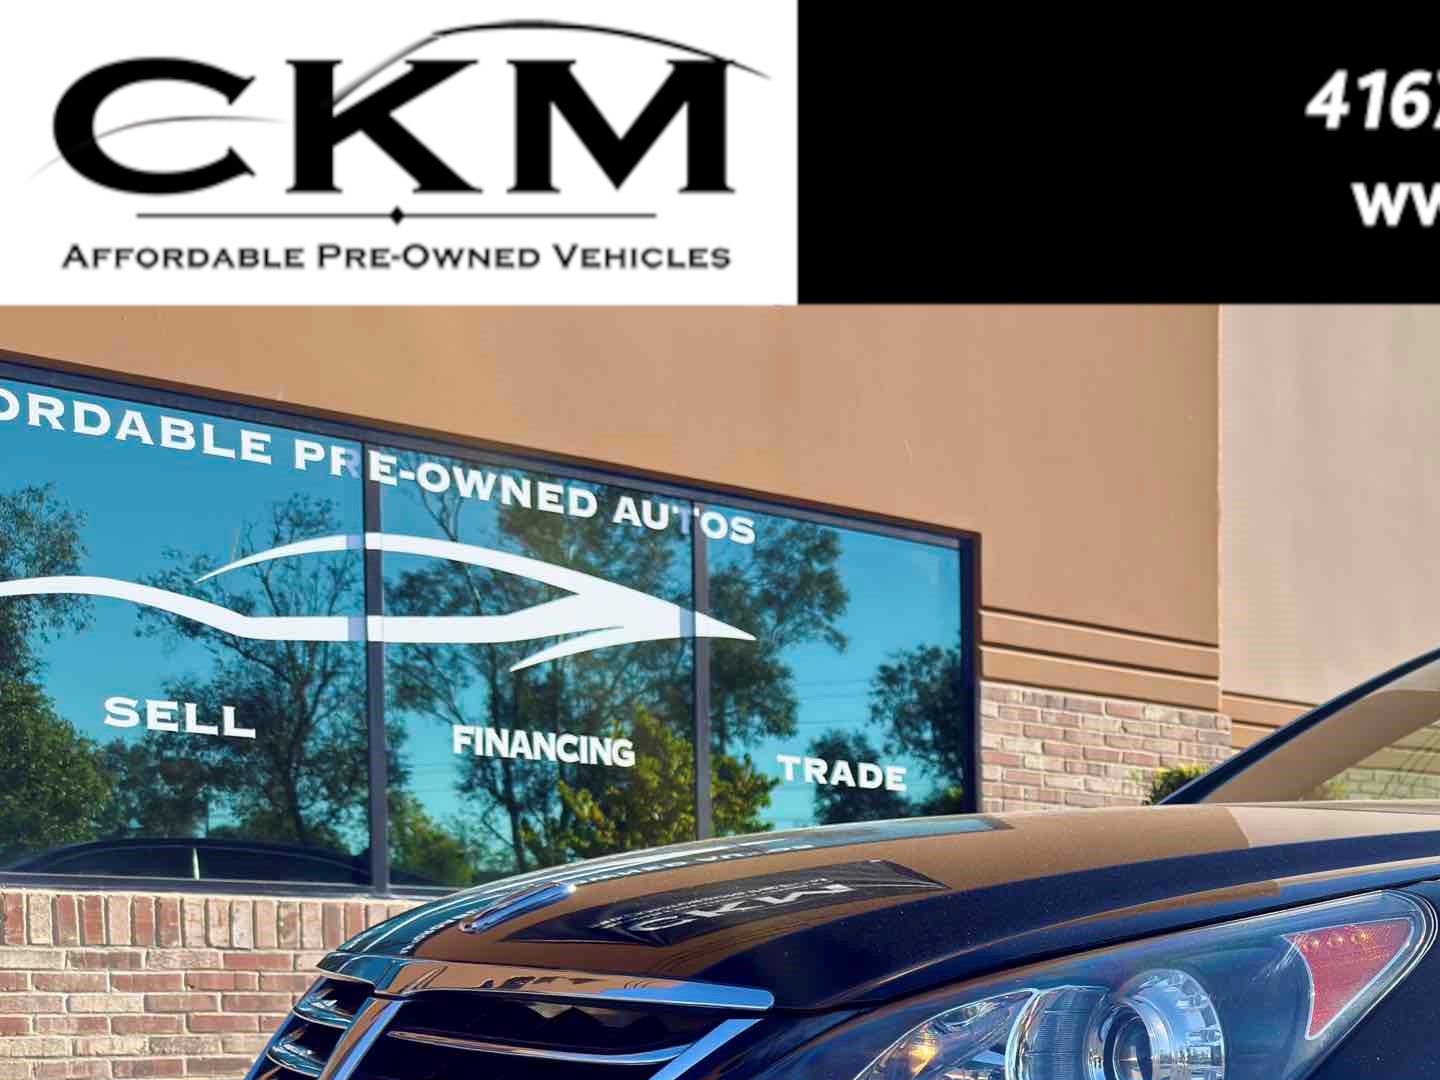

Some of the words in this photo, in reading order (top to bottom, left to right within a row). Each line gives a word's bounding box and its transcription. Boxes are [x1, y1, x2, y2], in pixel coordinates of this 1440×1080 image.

[293, 438, 598, 519] PRE-OWNED
[613, 496, 756, 545] AUTOS
[104, 696, 256, 739] SELL
[453, 724, 635, 767] FINANCING
[777, 754, 907, 792] TRADE
